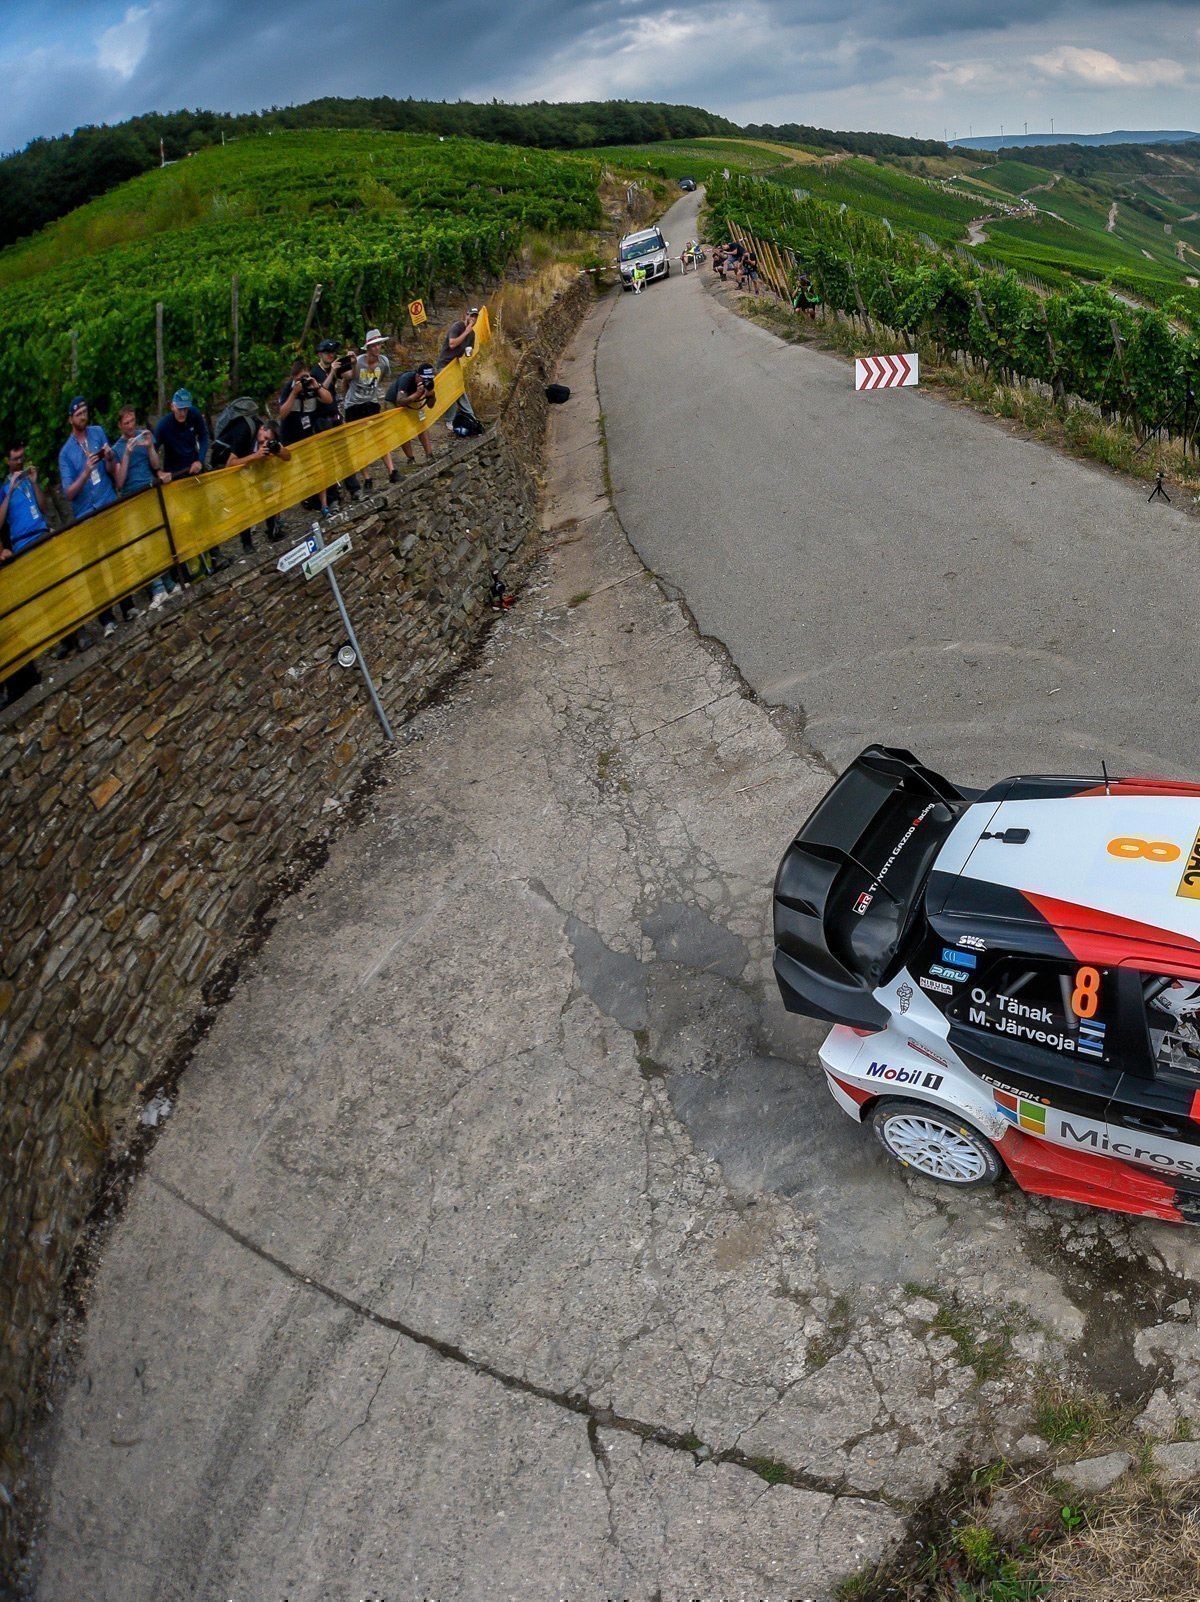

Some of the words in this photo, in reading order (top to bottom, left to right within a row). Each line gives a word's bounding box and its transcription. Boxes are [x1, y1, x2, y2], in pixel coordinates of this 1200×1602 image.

[307, 540, 315, 552] P
[858, 895, 871, 913] GR
[892, 826, 916, 856] GAZOO
[912, 803, 936, 827] Racing
[1106, 837, 1181, 862] 8
[970, 987, 990, 1006] O.
[996, 994, 1053, 1025] Tänak
[1071, 966, 1100, 1018] 8
[969, 1008, 991, 1028] M.
[995, 1017, 1075, 1051] Järveoja
[866, 1062, 922, 1085] Mobil
